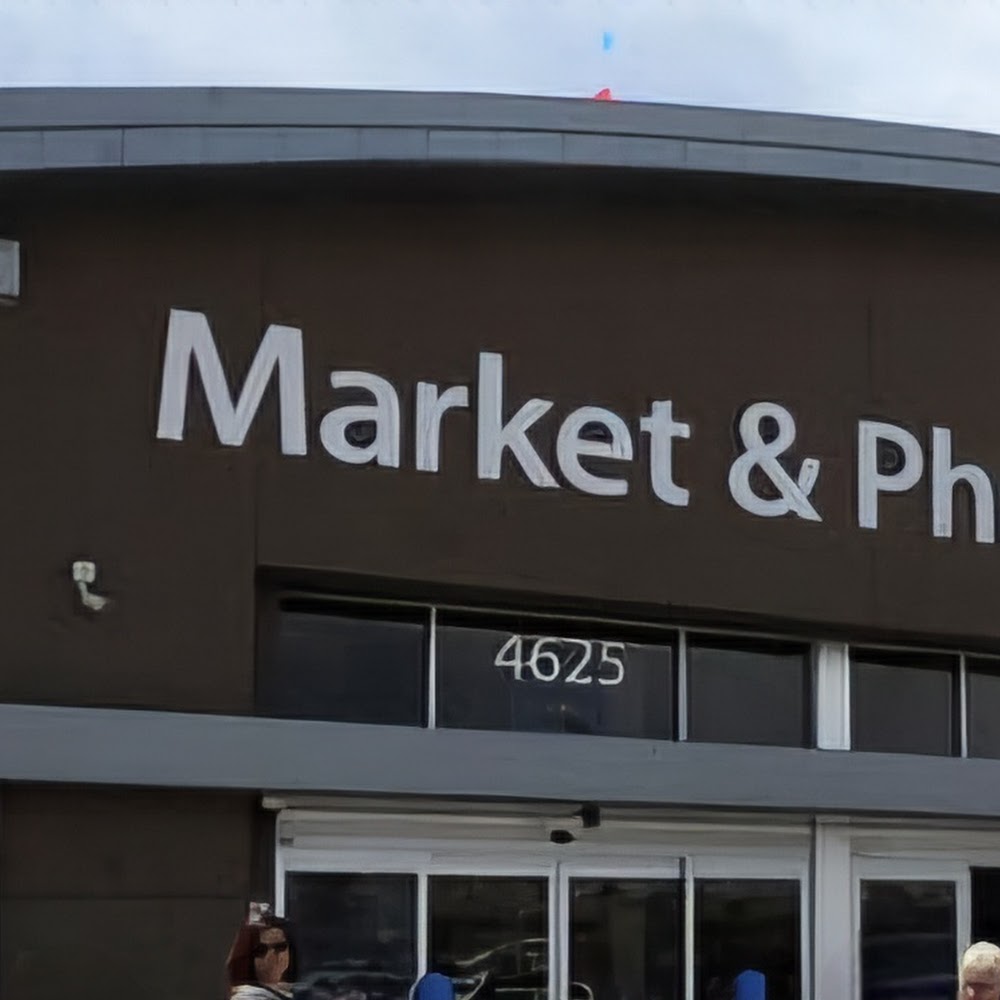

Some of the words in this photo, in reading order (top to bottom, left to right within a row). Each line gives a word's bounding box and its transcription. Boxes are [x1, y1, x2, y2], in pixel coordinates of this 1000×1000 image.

[156, 308, 691, 507] Market
[728, 402, 822, 522] &
[494, 635, 625, 685] 4625
